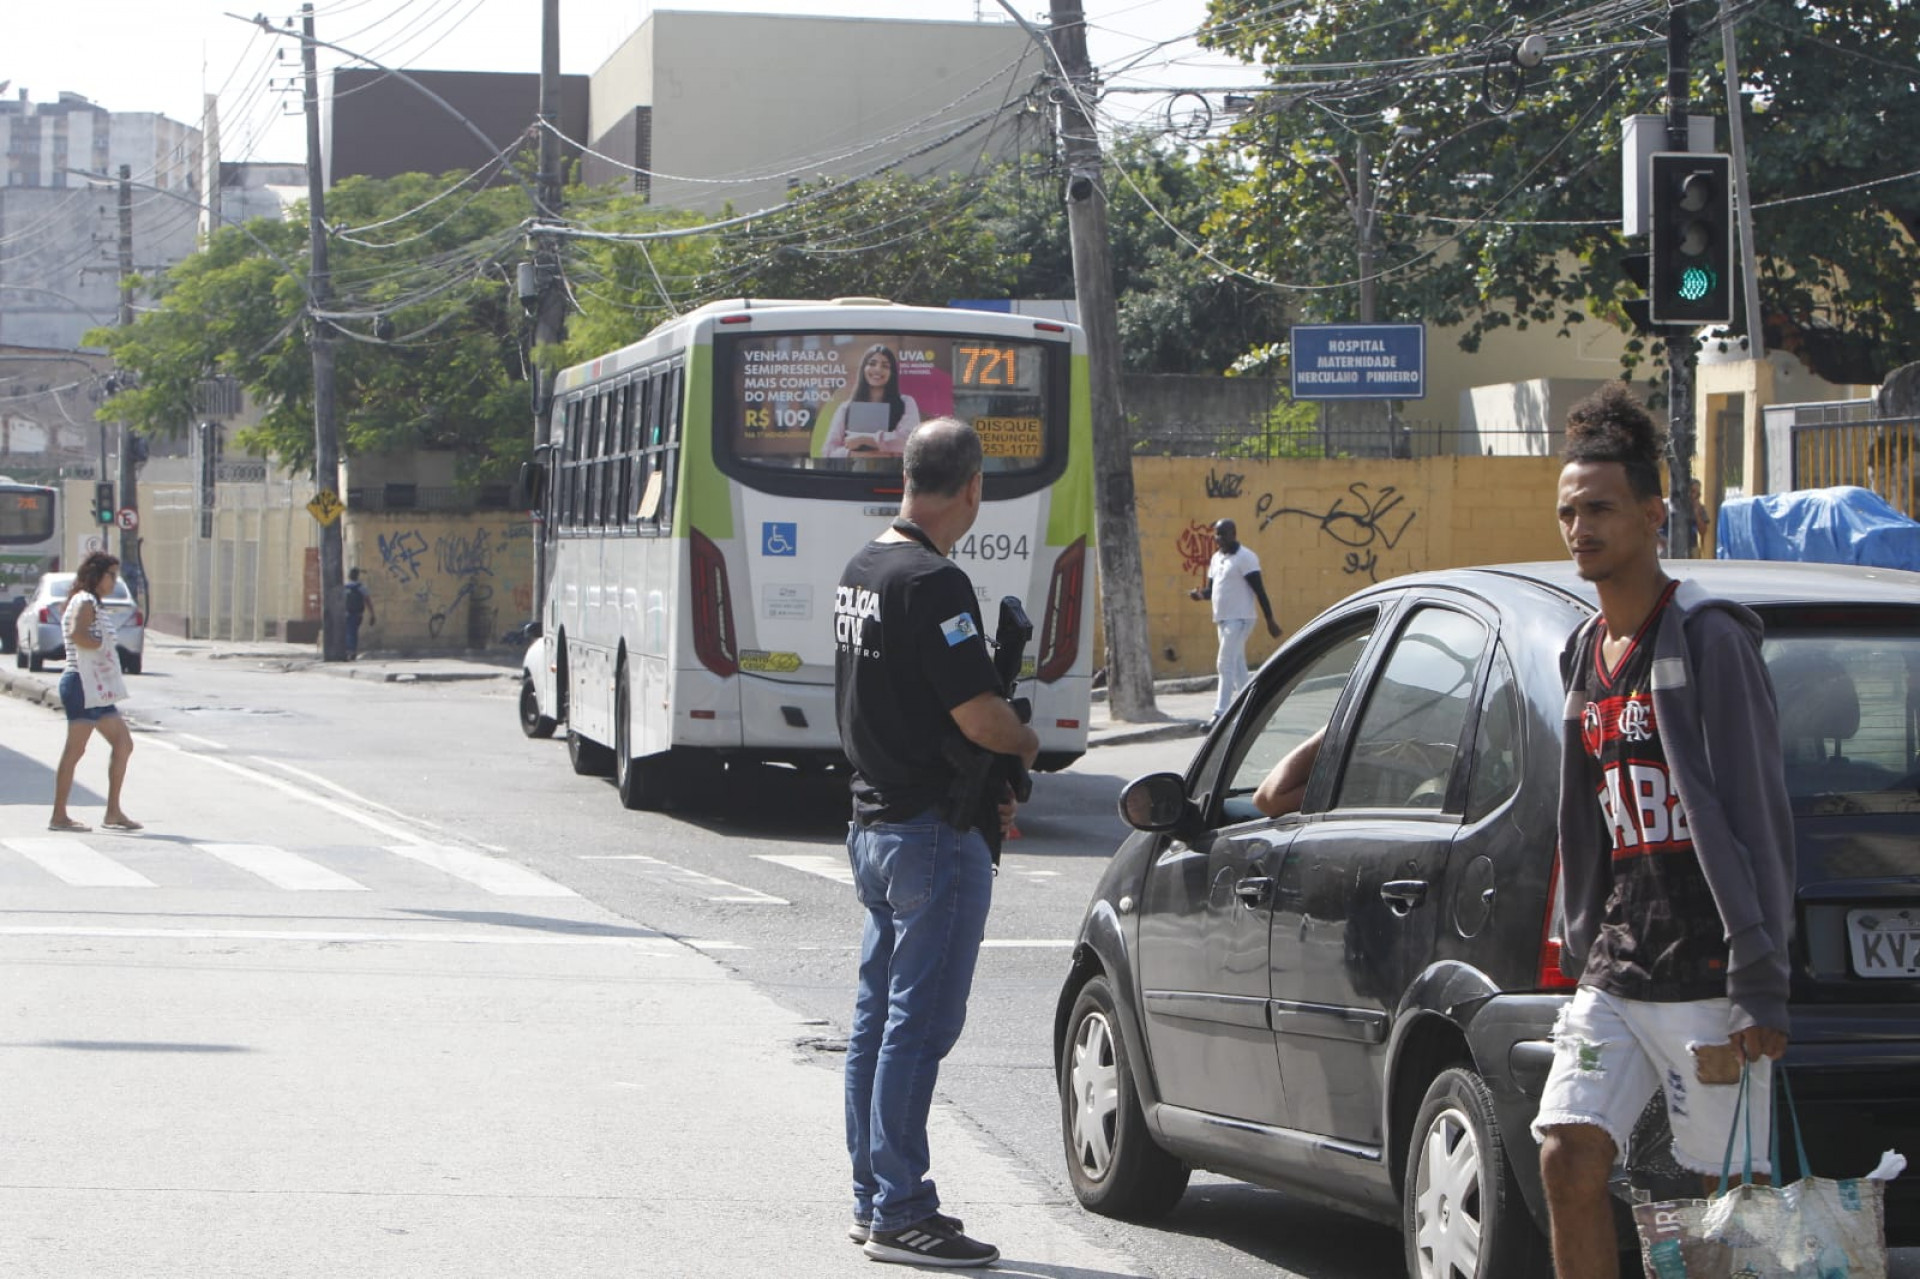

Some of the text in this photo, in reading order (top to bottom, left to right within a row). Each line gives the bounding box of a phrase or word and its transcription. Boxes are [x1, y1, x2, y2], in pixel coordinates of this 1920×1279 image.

[1328, 340, 1386, 352] HOSPITAL
[744, 350, 839, 361] VENHA PARA O
[899, 350, 925, 361] UVA
[959, 347, 1016, 385] 721
[1317, 356, 1397, 368] MATERNIDADE
[744, 364, 848, 375] SEMIPRESENCIAL
[744, 377, 846, 388] MAIS COMPLETO
[1297, 371, 1419, 383] HERCULANO PINHEIRO
[745, 391, 831, 402] DO MERCADO
[745, 407, 810, 429] R$ 109
[976, 420, 1038, 432] DISQUE
